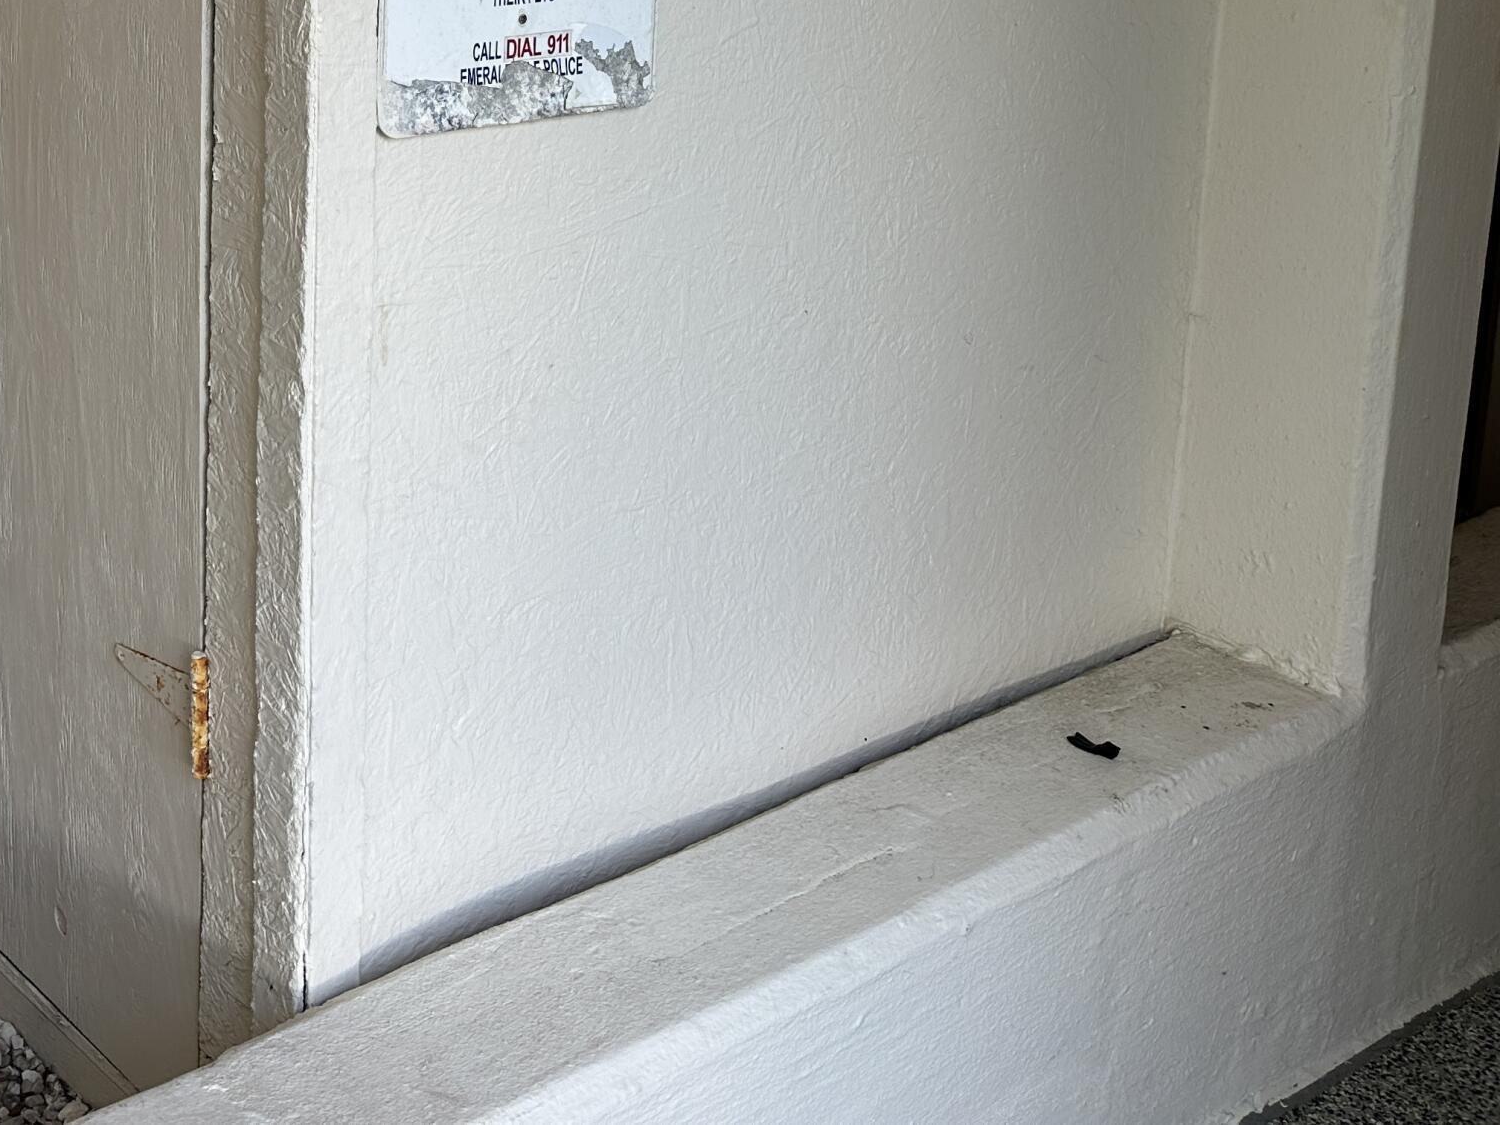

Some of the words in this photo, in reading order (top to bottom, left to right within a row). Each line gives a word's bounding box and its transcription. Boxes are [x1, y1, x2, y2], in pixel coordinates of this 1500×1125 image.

[473, 41, 501, 62] CALL
[507, 37, 541, 59] DIAL
[548, 33, 570, 54] 911
[460, 63, 510, 86] EMERAL
[543, 56, 583, 76] POLICE
